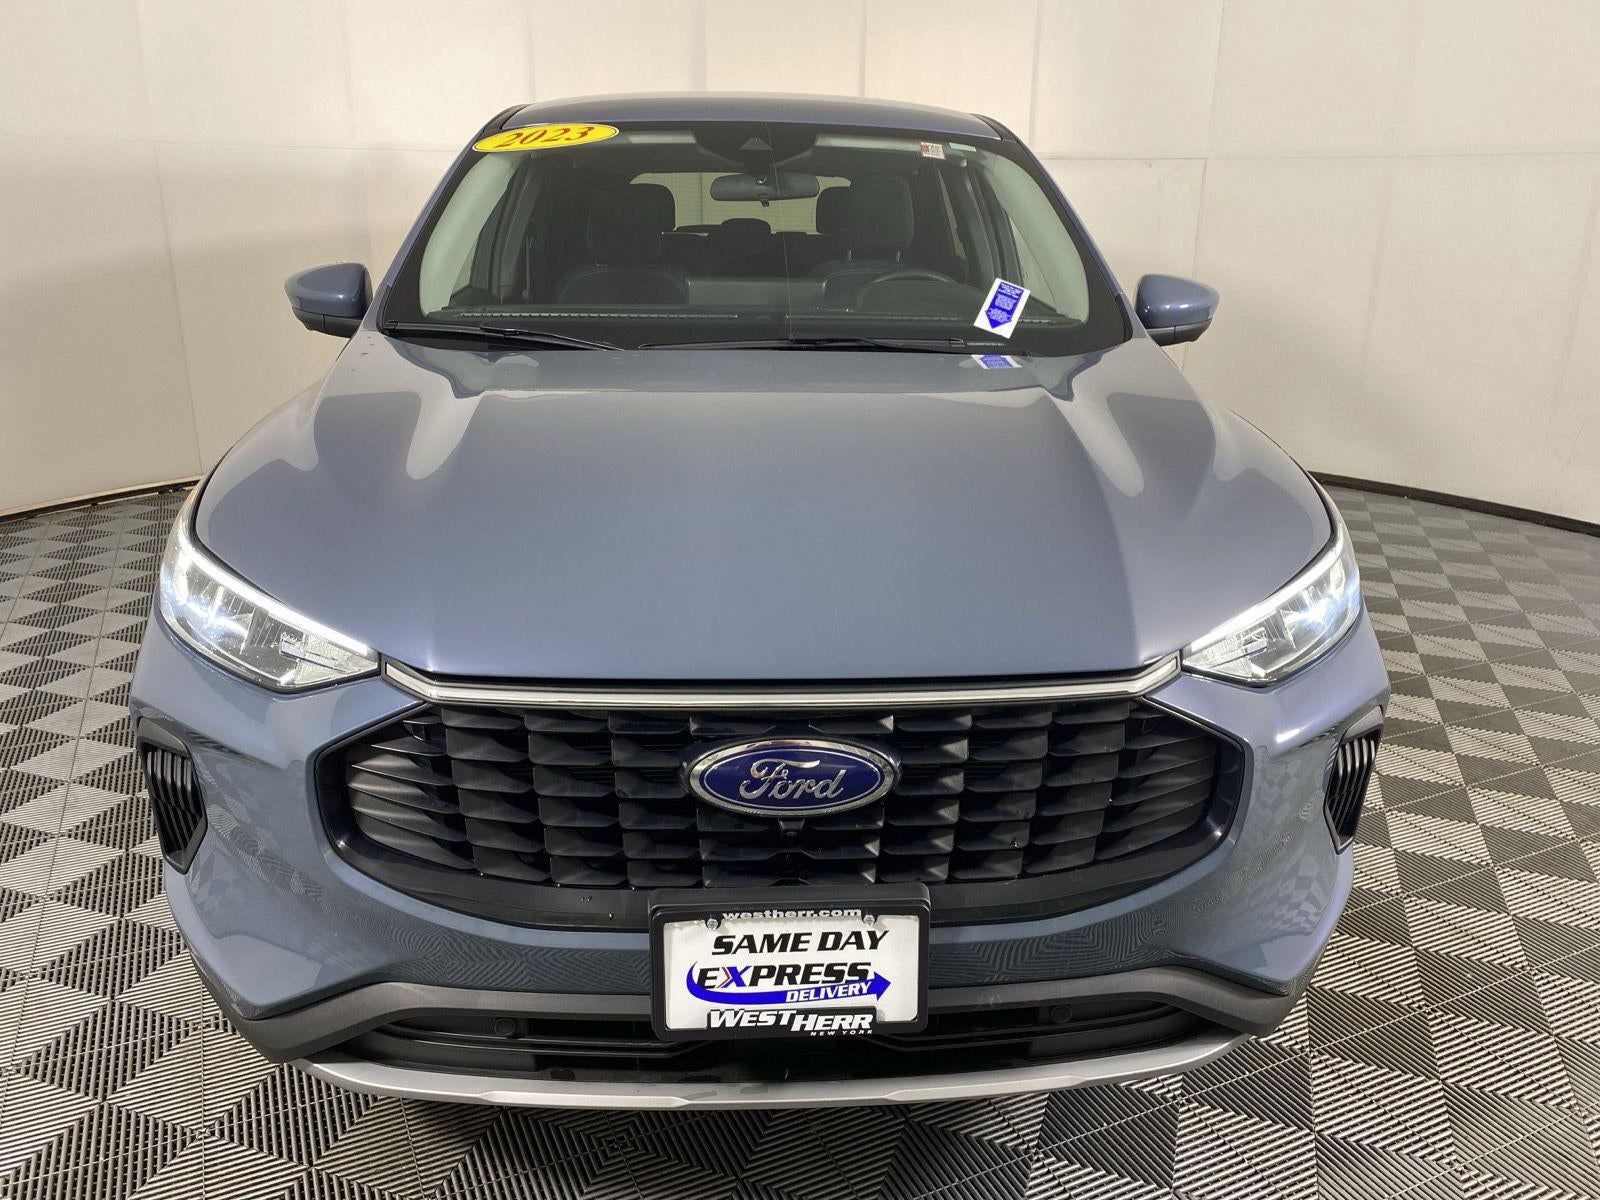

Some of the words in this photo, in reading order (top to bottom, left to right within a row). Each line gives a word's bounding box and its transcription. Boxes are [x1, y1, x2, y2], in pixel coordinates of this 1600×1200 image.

[494, 126, 595, 149] 2023
[739, 758, 847, 800] Ford
[722, 909, 862, 920] westherr.com
[711, 932, 813, 956] SAME
[817, 930, 890, 951] DAY
[697, 962, 872, 989] EXPRESS
[785, 980, 873, 1004] DELIVERY
